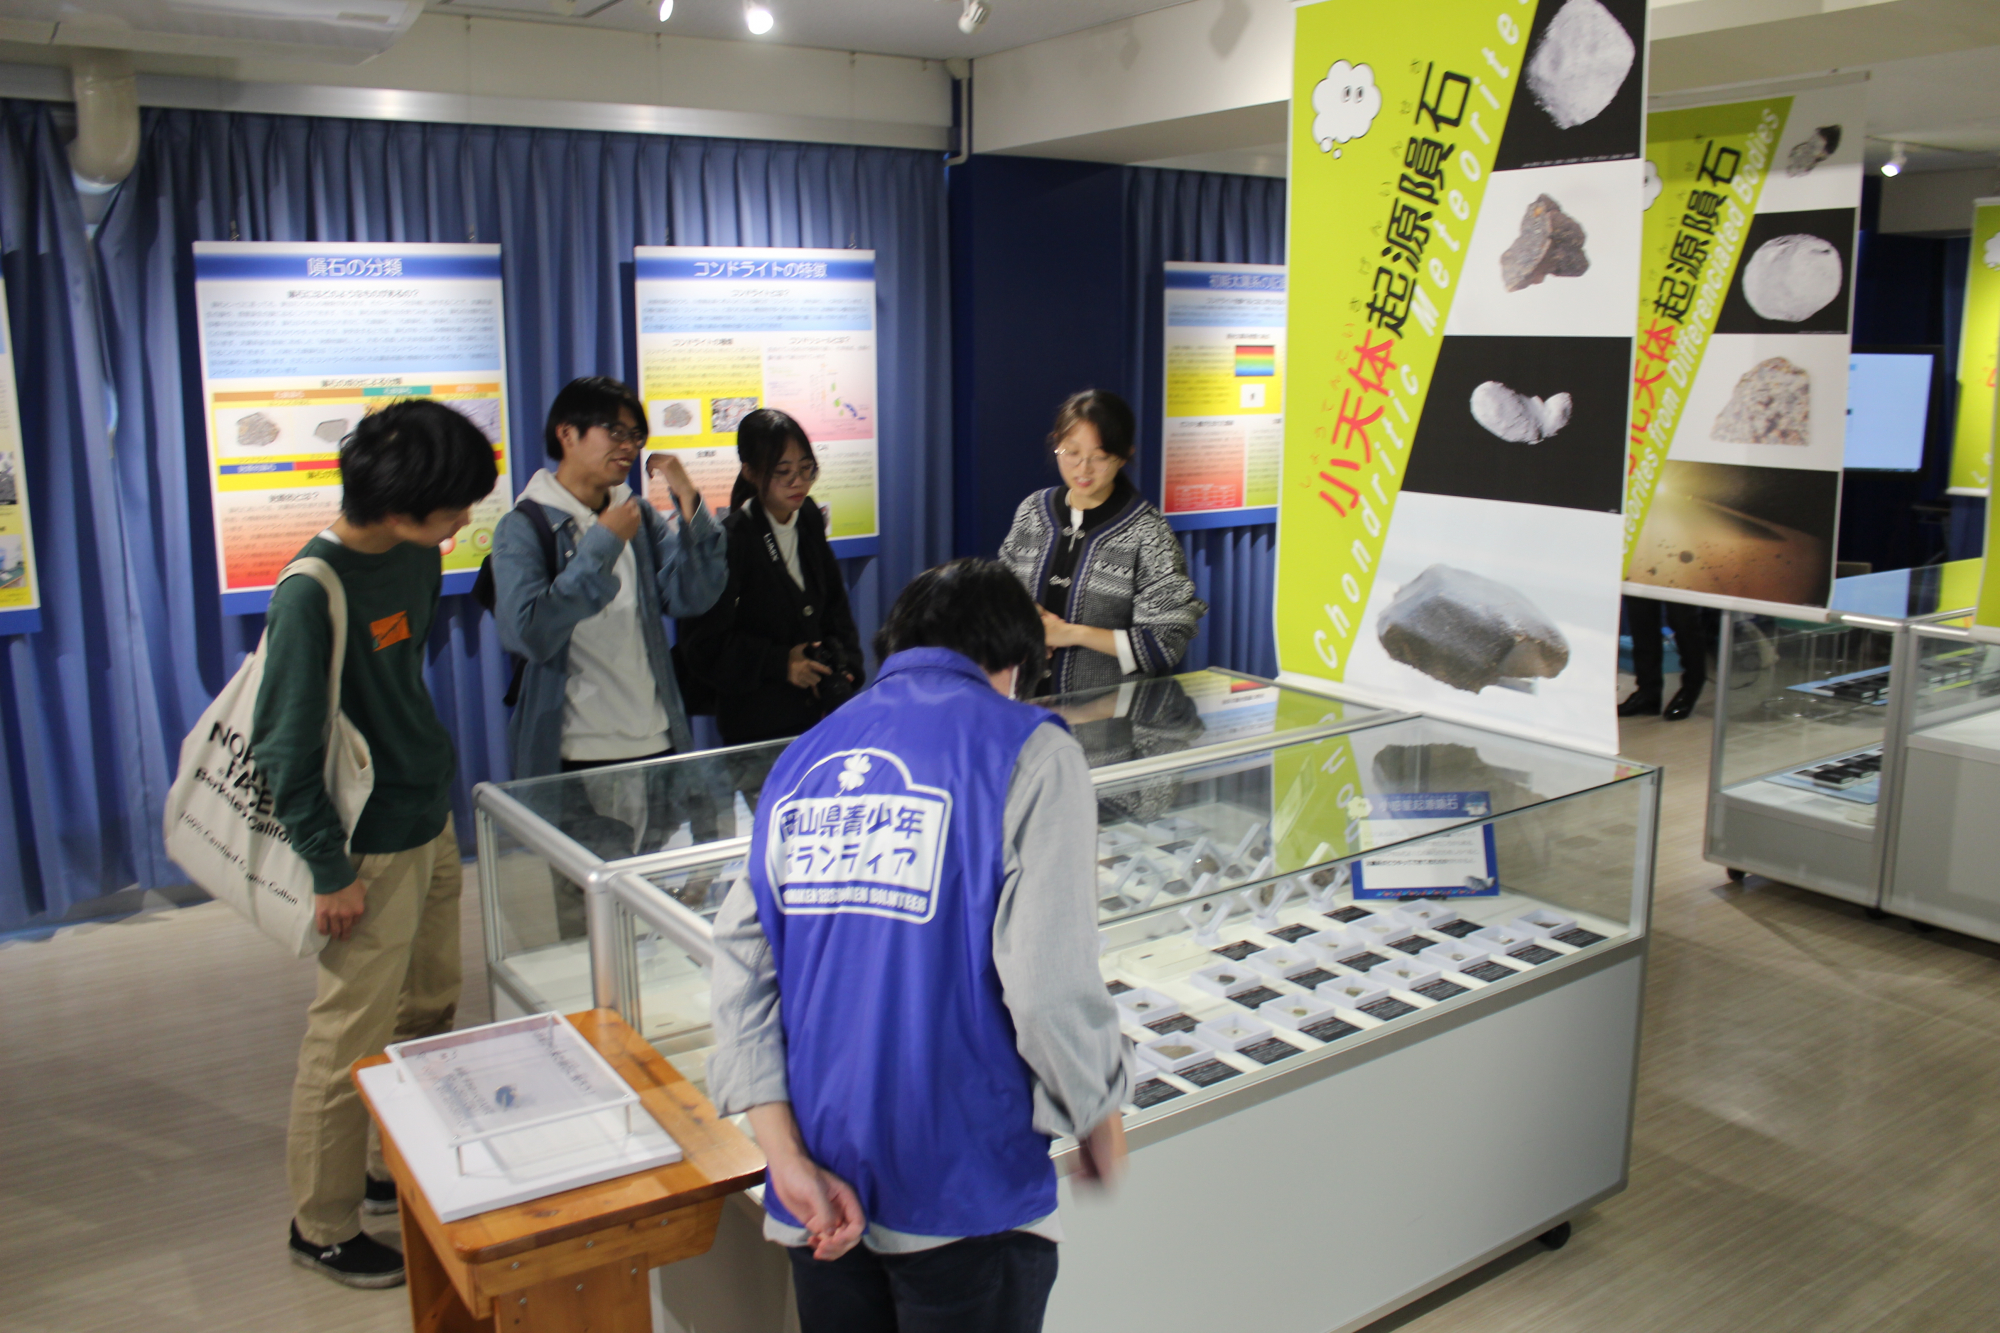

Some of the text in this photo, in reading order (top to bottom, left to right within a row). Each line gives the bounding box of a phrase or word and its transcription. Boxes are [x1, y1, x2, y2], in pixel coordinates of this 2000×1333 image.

[1731, 107, 1780, 205] Bodies
[306, 256, 404, 278] 隕石の分類
[693, 260, 829, 279] コンドライトの特徴
[1318, 60, 1473, 518] 小天体起源隕石
[1313, 364, 1419, 669] Chondritic
[1410, 0, 1530, 337] Meteorite
